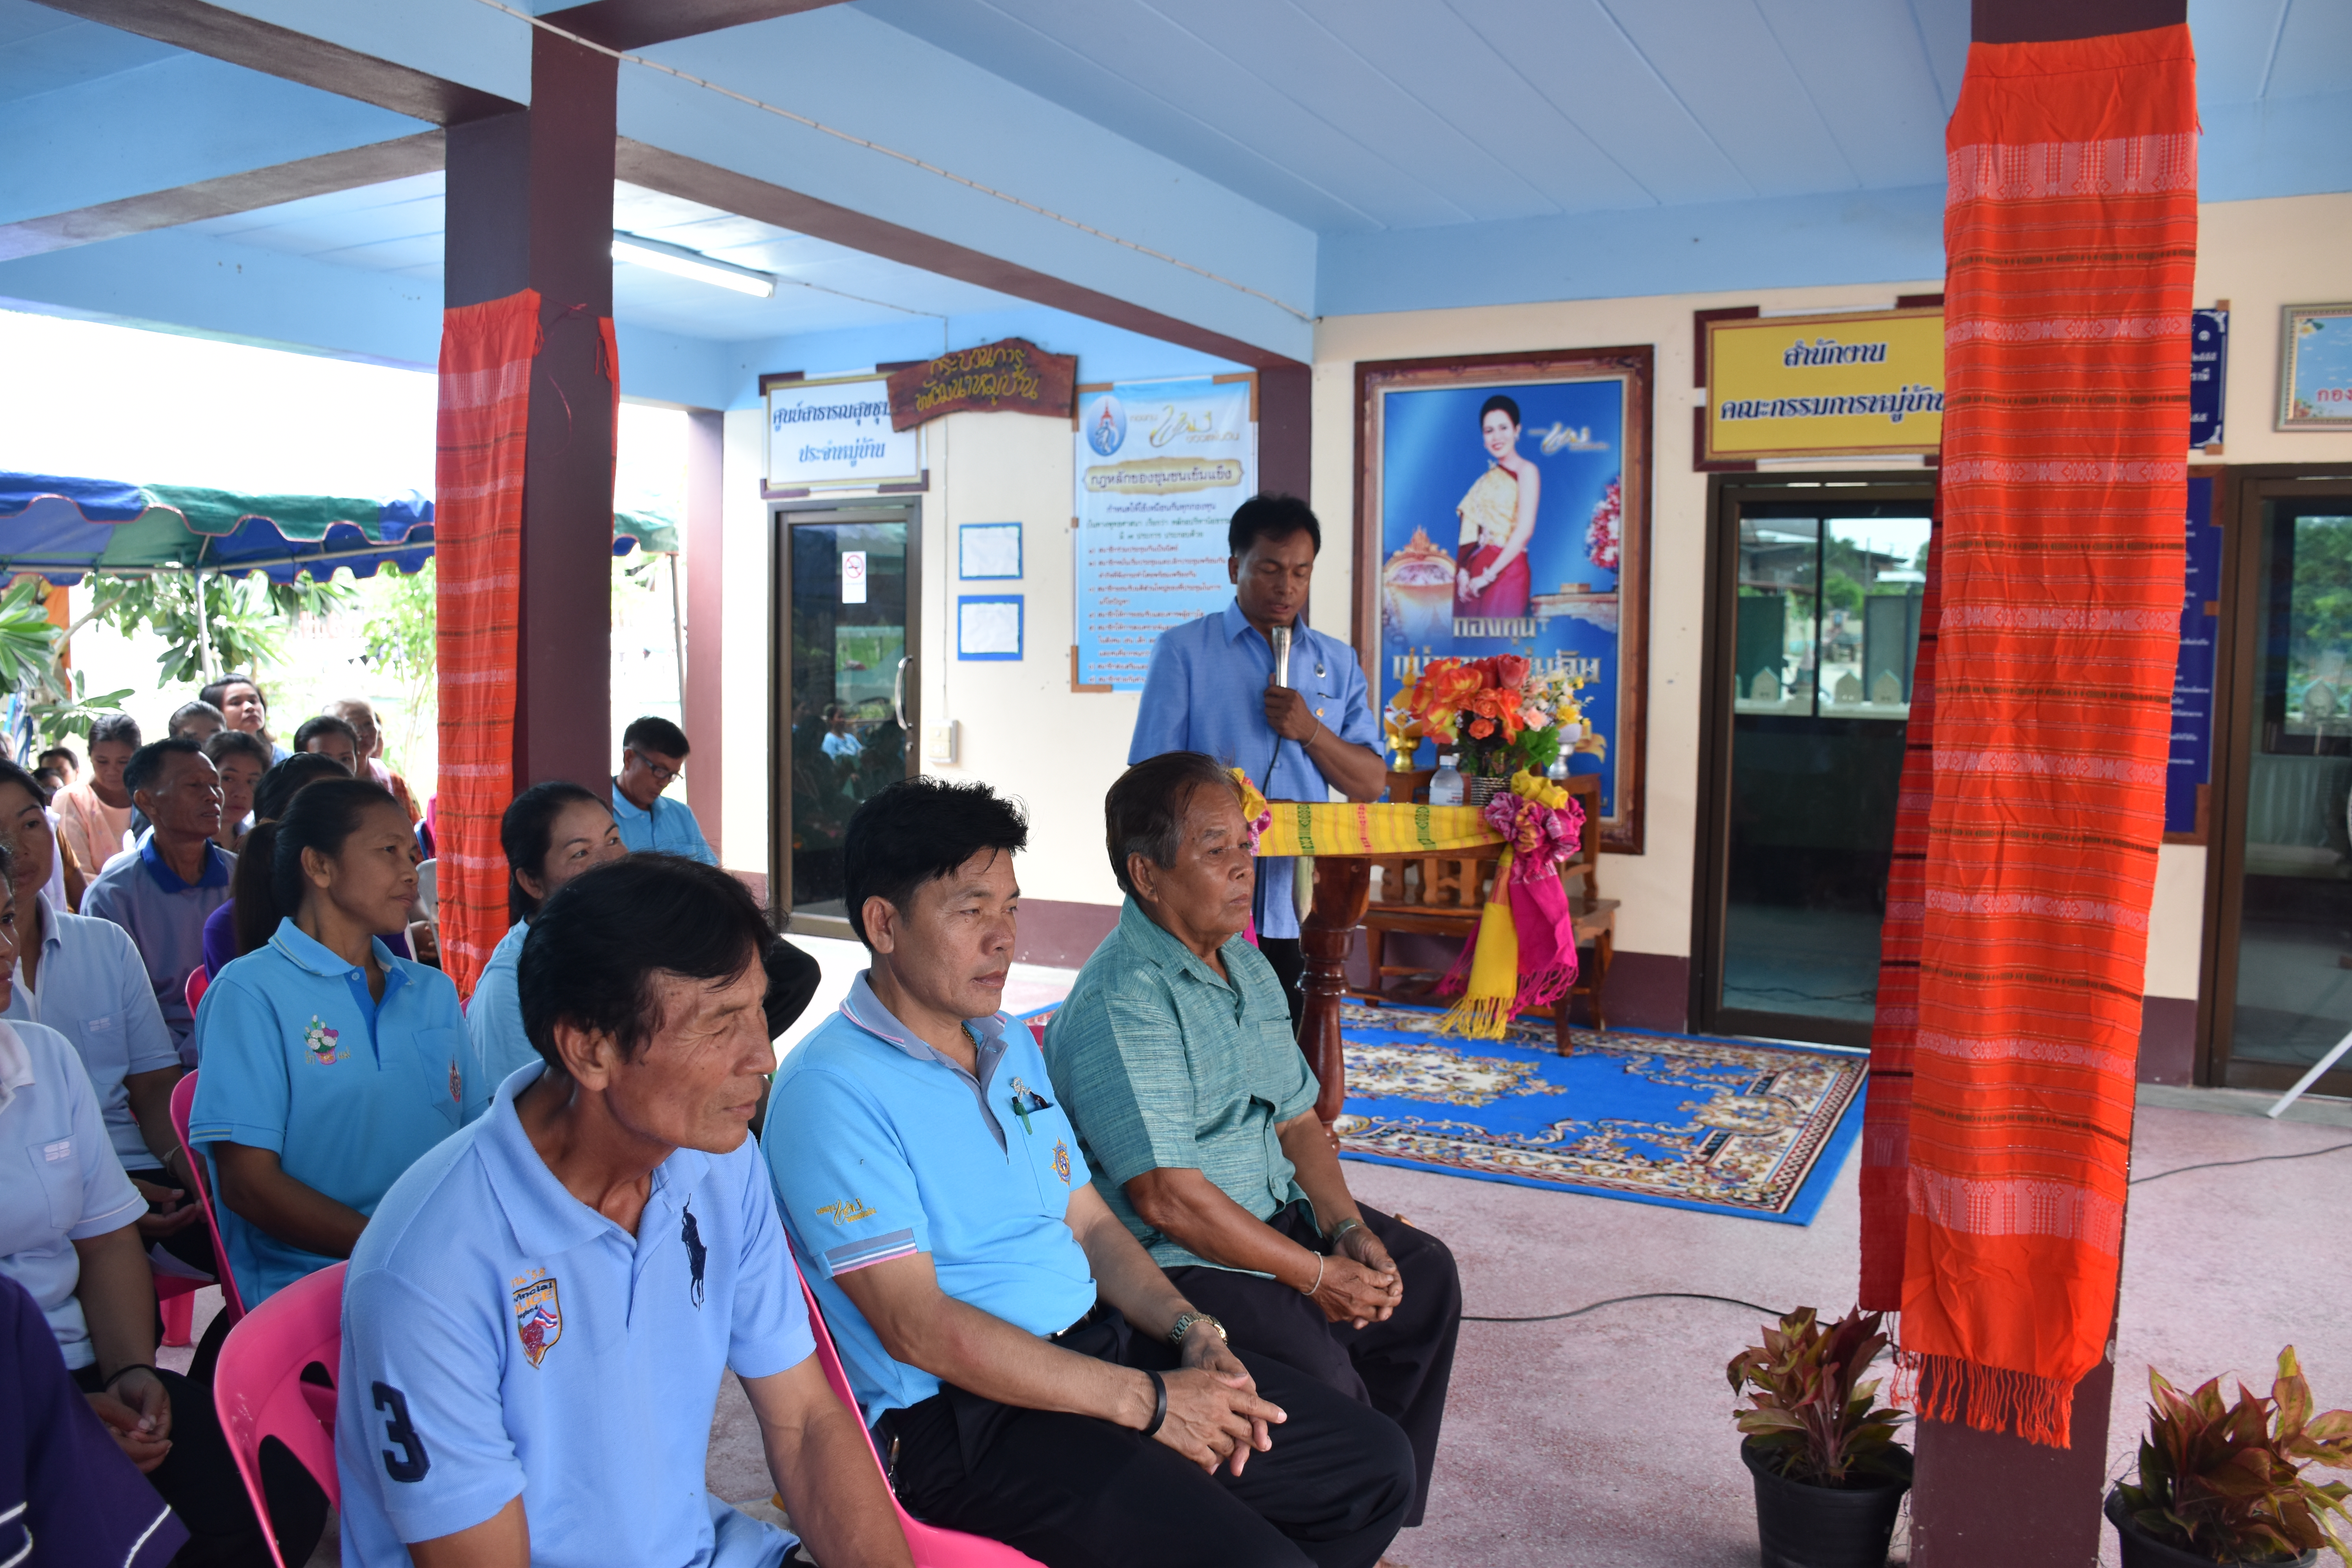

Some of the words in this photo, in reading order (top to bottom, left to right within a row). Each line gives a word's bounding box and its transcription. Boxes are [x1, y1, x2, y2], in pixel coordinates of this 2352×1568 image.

[930, 348, 1025, 375] กระบวนการ
[1784, 339, 1886, 367] สำนักงาน
[915, 368, 1040, 411] พัฒนาหมู่บ้าน
[773, 401, 890, 431] ศูนย์สาธารณสุขชุม
[799, 437, 885, 467] ประจำหมู่บ้าน
[514, 1282, 553, 1302] vincial
[515, 1290, 553, 1314] LICE
[372, 1381, 431, 1483] 3
